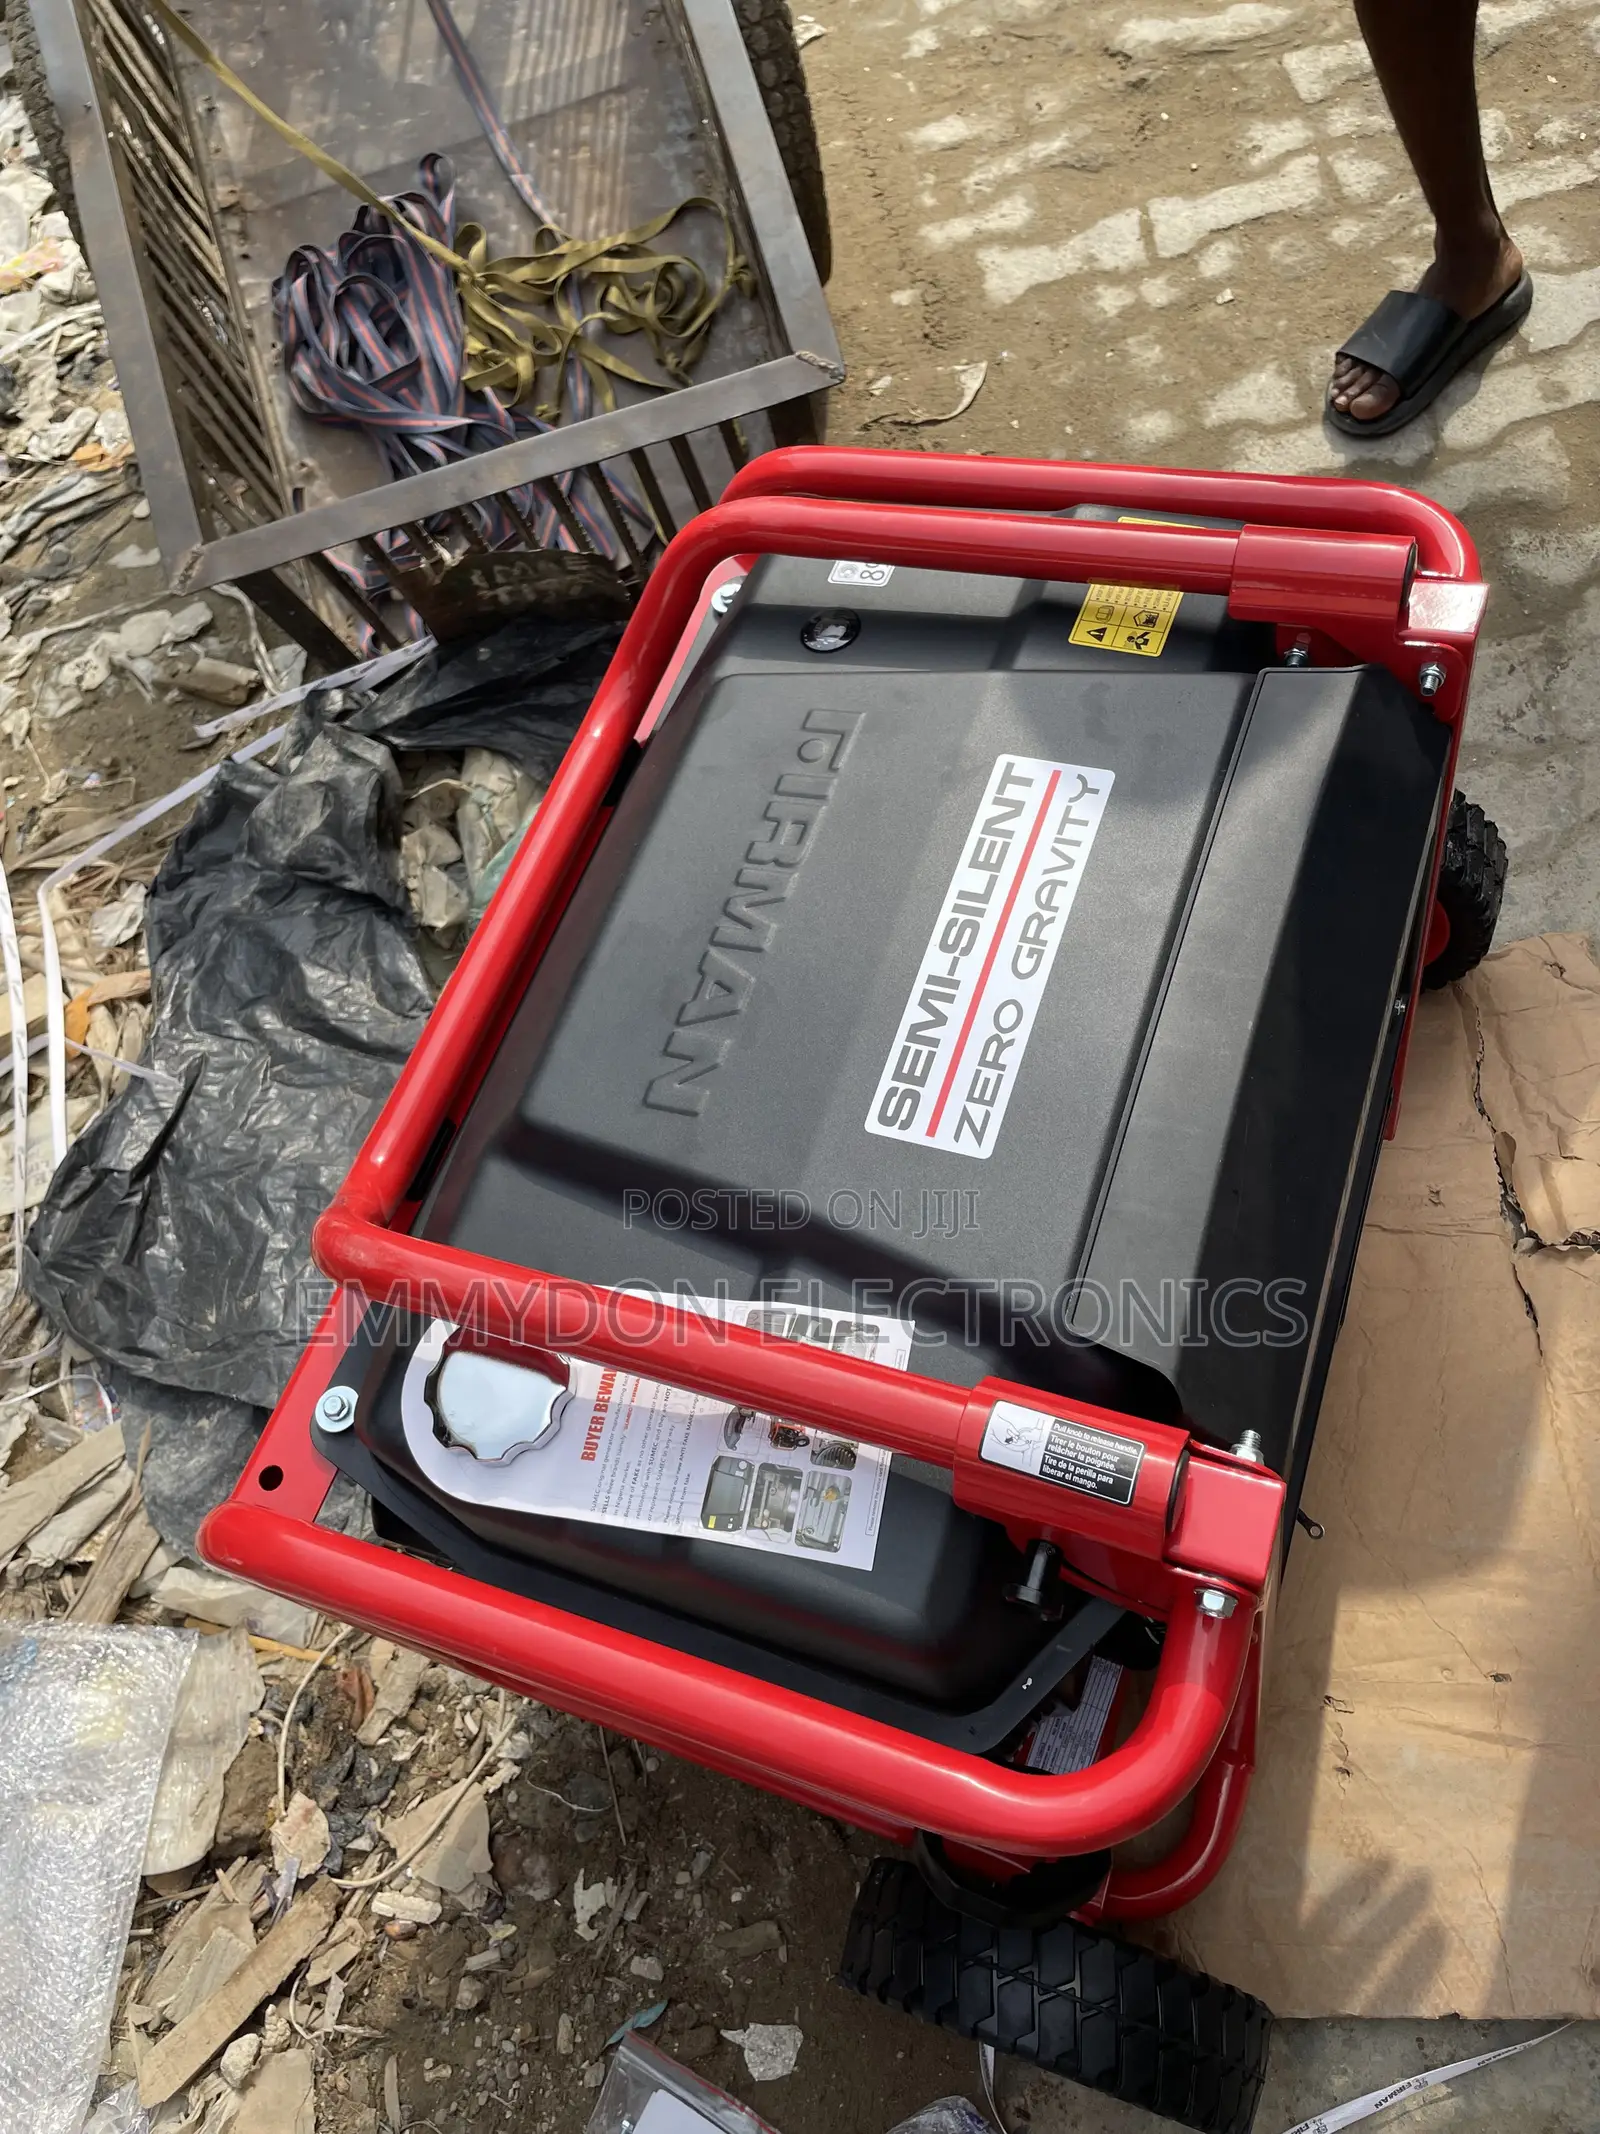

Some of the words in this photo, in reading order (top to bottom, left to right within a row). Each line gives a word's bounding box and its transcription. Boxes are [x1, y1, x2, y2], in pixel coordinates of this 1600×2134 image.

[877, 762, 1034, 1131] SEMI-SILENT
[953, 999, 1023, 1148] ZERO
[1011, 774, 1100, 980] GRAVITY
[581, 1414, 604, 1461] BUYER
[591, 1488, 600, 1512] SUMEC
[604, 1432, 615, 1462] generator
[612, 1387, 627, 1431] manufacturing
[1050, 1435, 1066, 1445] Tirer
[1076, 1443, 1101, 1456] bouton
[1101, 1453, 1118, 1463] pour
[1054, 1423, 1066, 1431] Pull
[1066, 1427, 1082, 1436] knob
[1090, 1435, 1114, 1447] release
[1114, 1442, 1138, 1454] handle.
[648, 1442, 657, 1465] SUMEC
[1047, 1442, 1076, 1457] relâcher
[1085, 1455, 1116, 1471] poignée.
[656, 1457, 666, 1480] SUMEC
[1042, 1464, 1064, 1477] liberar
[1072, 1476, 1098, 1489] mango.
[1043, 1455, 1057, 1465] Tire
[1058, 1460, 1067, 1468] de
[1075, 1466, 1096, 1479] perilla
[1097, 1474, 1113, 1484] para
[602, 1495, 610, 1513] SELLS
[1374, 2081, 1413, 2109] FIRMAN
